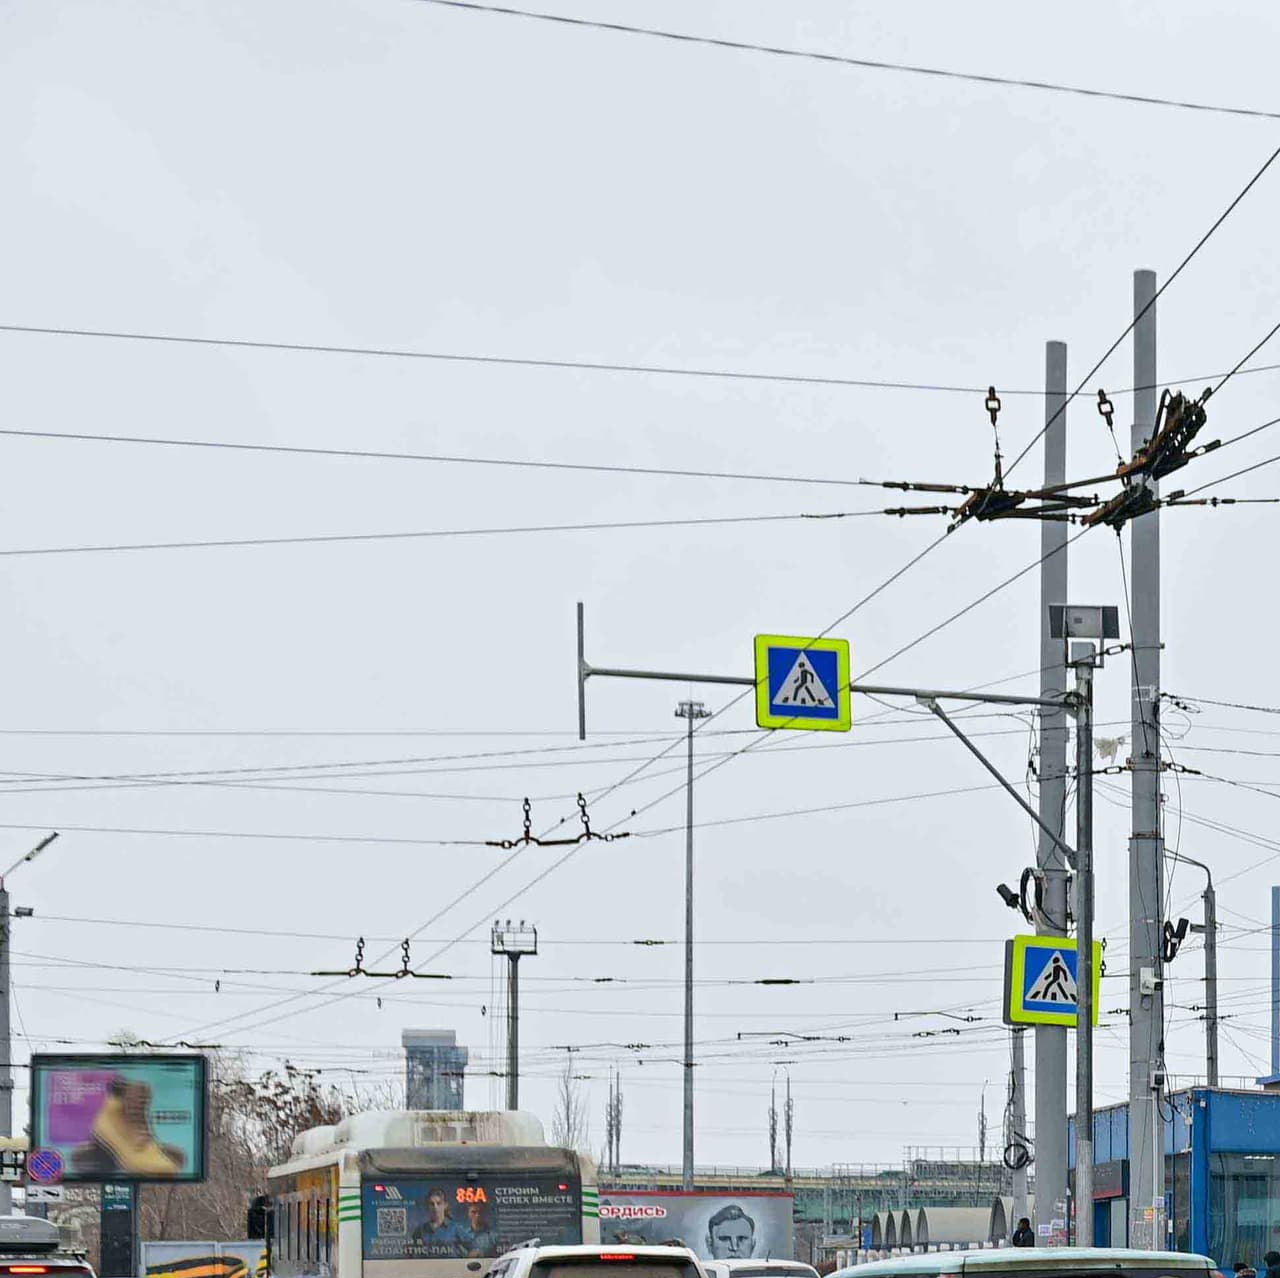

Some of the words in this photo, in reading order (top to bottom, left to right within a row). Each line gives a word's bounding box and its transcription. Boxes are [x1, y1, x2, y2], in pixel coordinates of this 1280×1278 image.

[494, 1187, 539, 1196] СТРОИМ
[495, 1196, 530, 1205] УСПЕХ
[532, 1195, 573, 1204] ВМЕСТЕ
[599, 1205, 666, 1217] ОРДИСЬ
